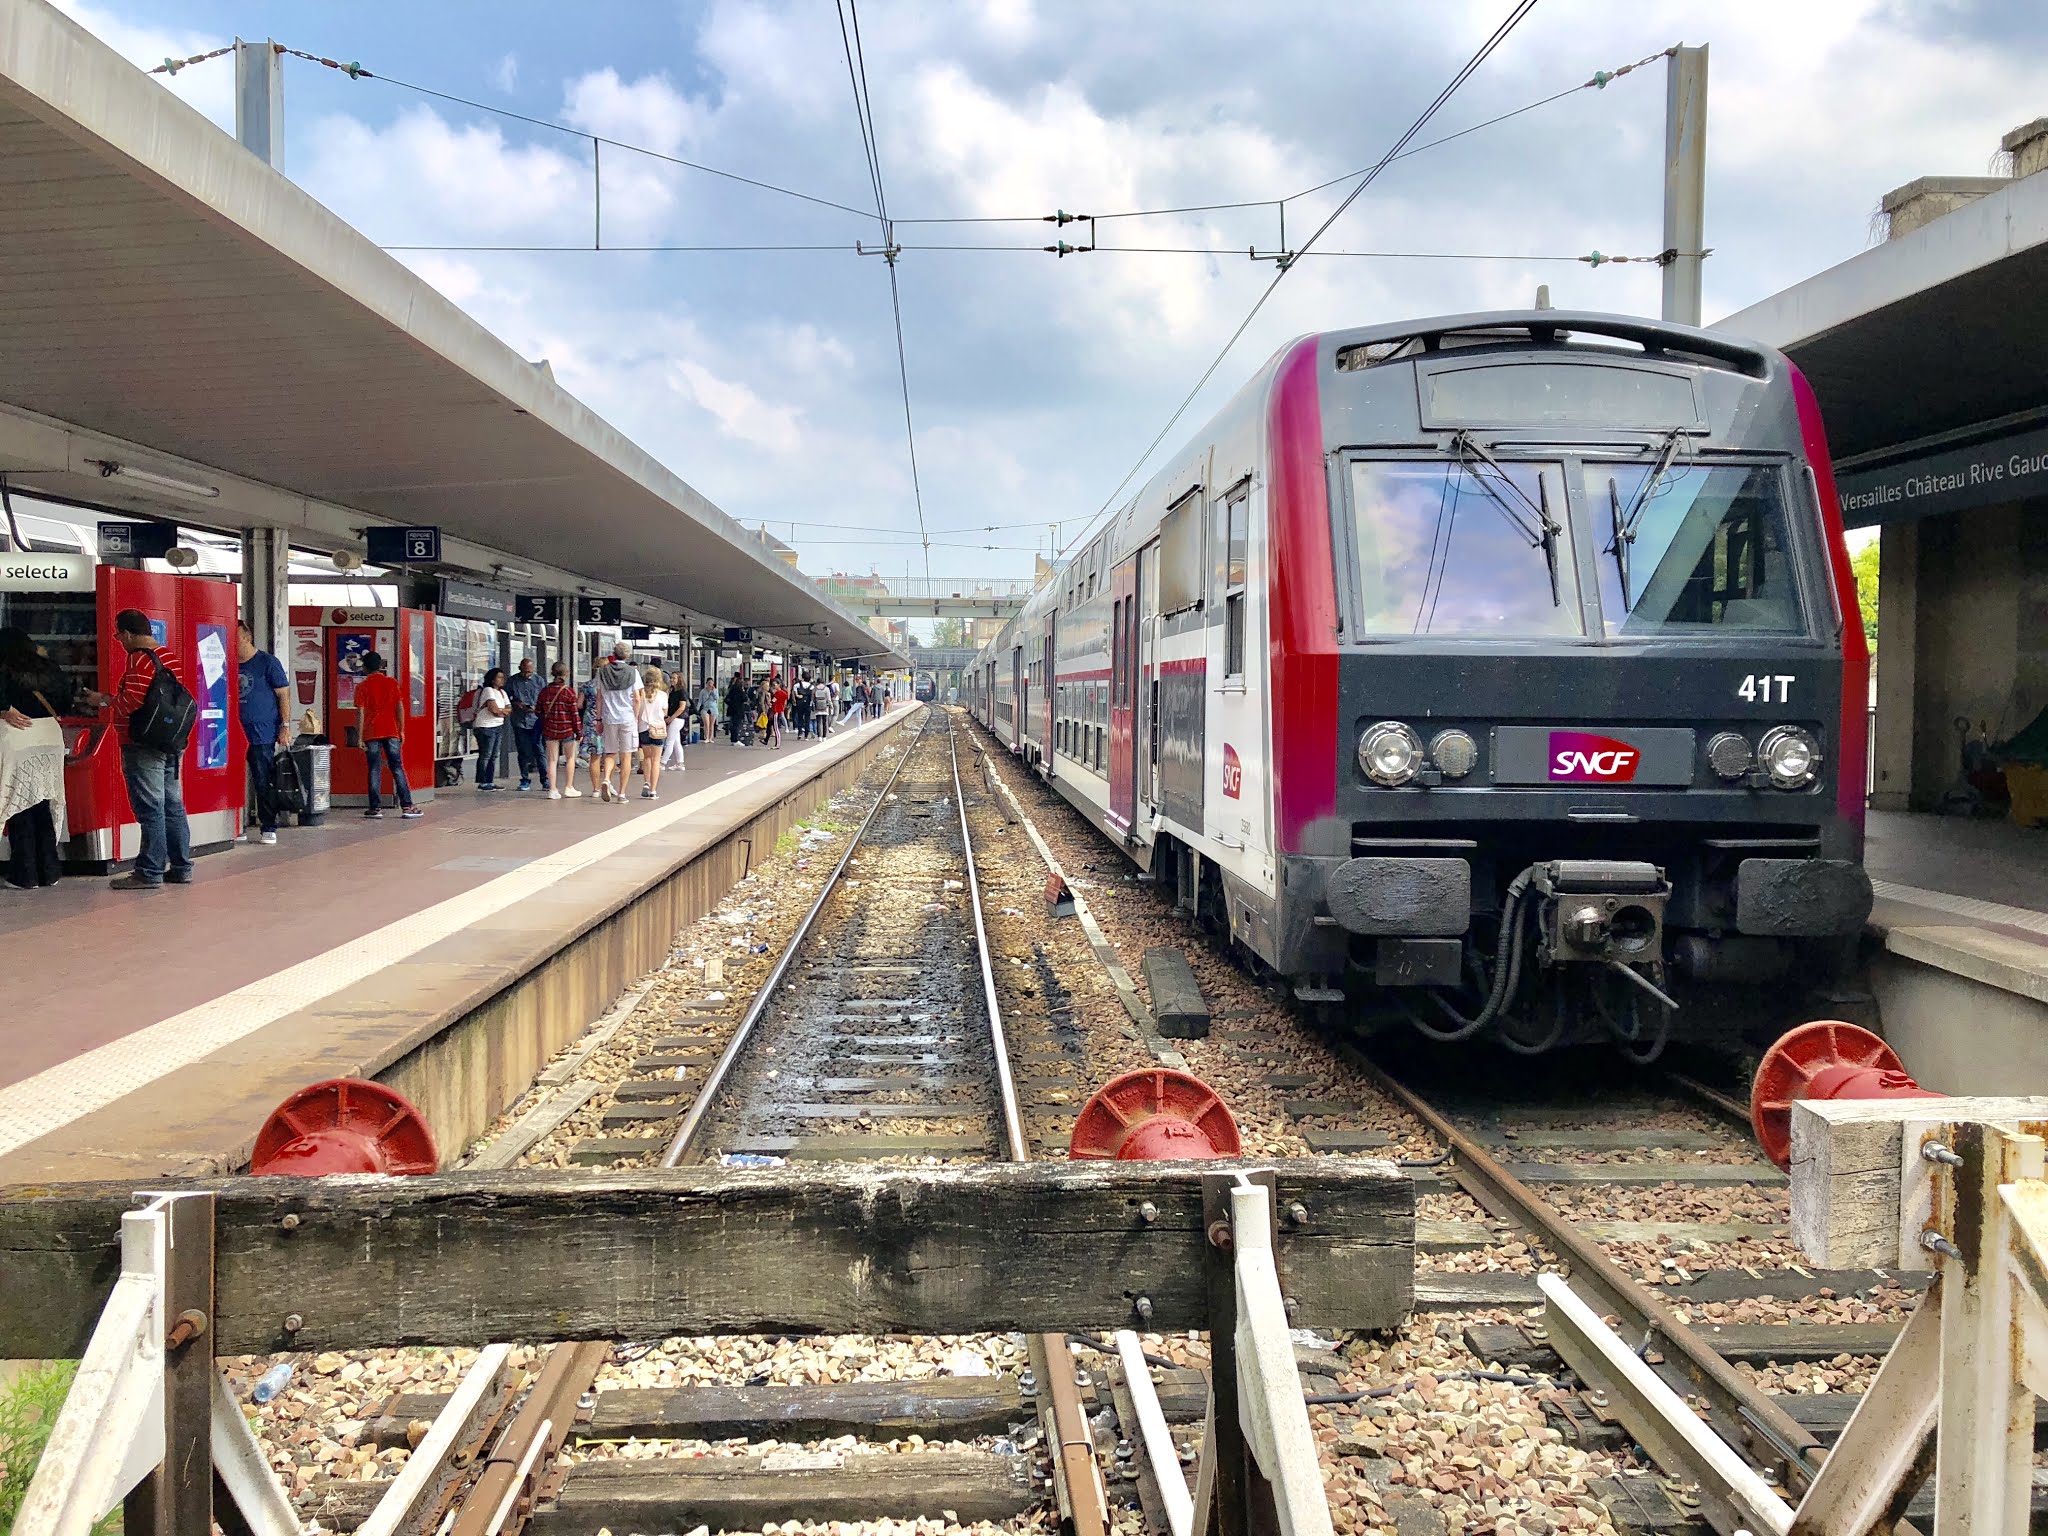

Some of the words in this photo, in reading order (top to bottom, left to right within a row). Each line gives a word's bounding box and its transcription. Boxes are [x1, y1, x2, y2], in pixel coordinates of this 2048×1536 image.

[1840, 486, 1902, 511] Versailles
[1905, 472, 1966, 498] Château
[1970, 463, 2004, 484] Rive
[110, 536, 121, 551] 8
[414, 541, 426, 556] 8
[5, 564, 69, 579] selecta
[349, 612, 385, 621] selecta
[533, 605, 544, 620] 2
[591, 607, 602, 622] 3
[1738, 675, 1796, 703] 41T
[1552, 751, 1634, 775] SNCF
[1223, 765, 1240, 791] SNCF
